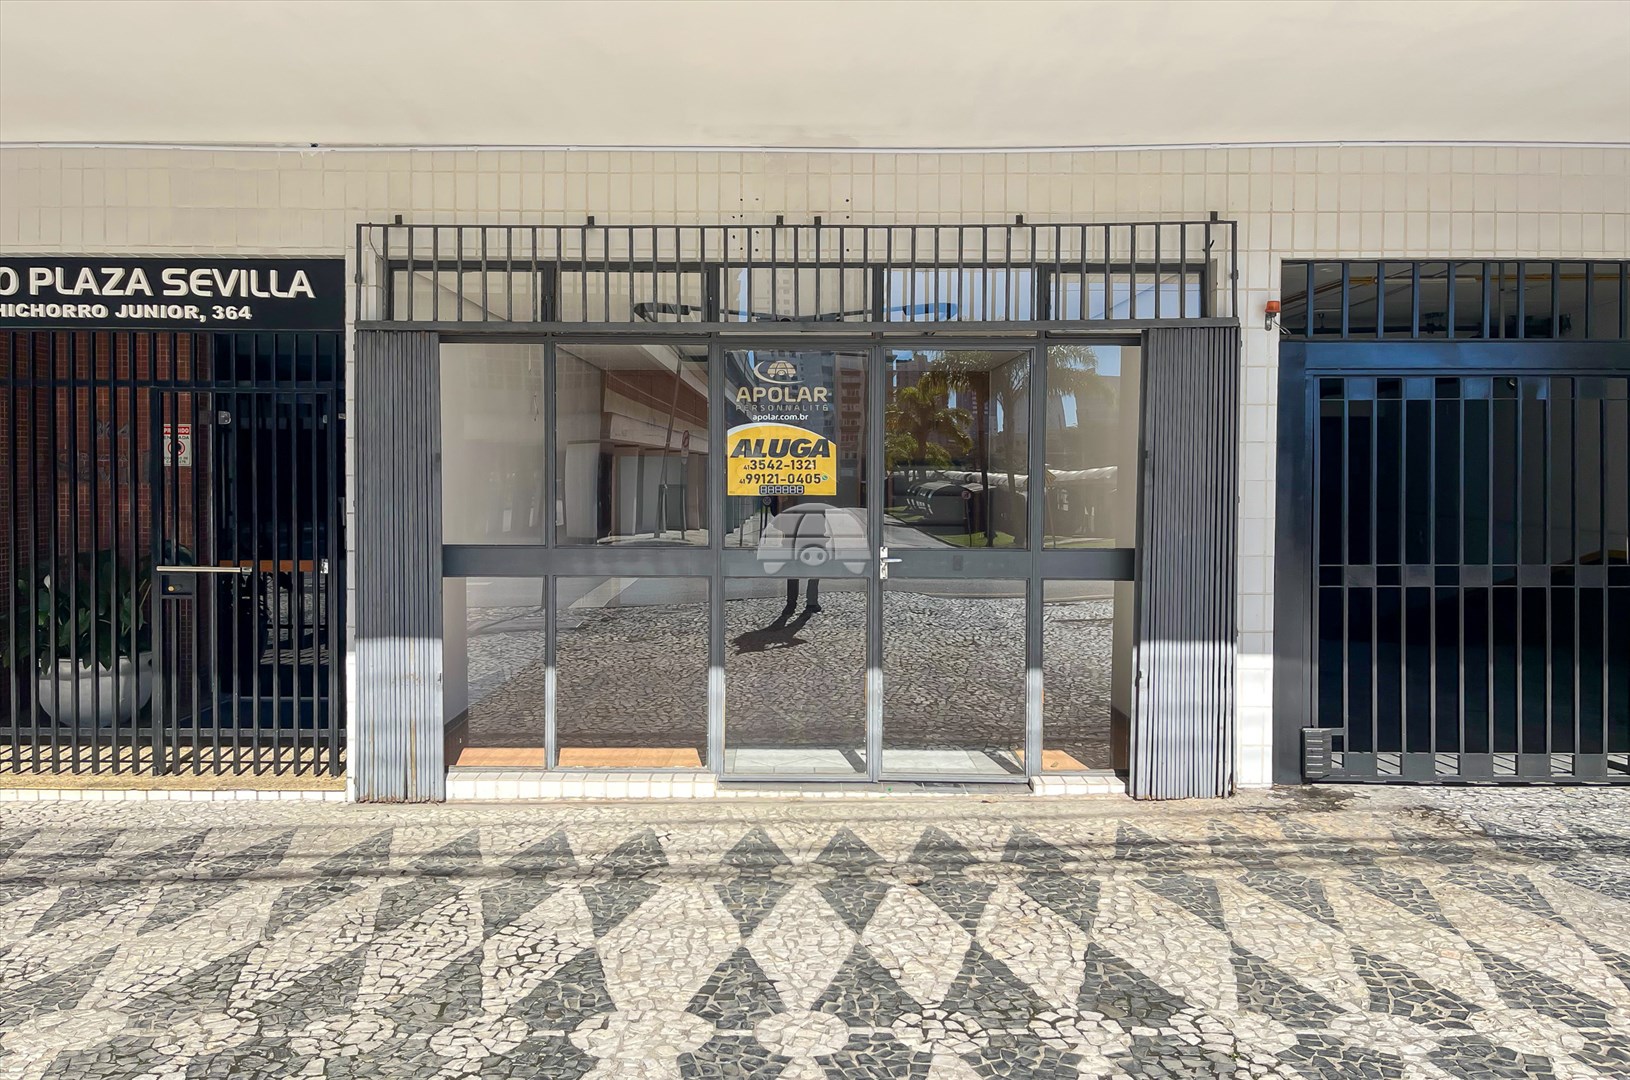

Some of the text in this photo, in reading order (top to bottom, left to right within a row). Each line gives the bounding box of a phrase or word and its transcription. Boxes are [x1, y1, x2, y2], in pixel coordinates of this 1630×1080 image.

[29, 267, 154, 296] PLAZA
[162, 268, 316, 298] SEVILLA
[115, 304, 206, 322] JUNIOR,
[212, 305, 252, 320] 364
[736, 386, 828, 402] APOLAR
[752, 413, 809, 421] apolar.com.br
[730, 438, 831, 458] ALUGA
